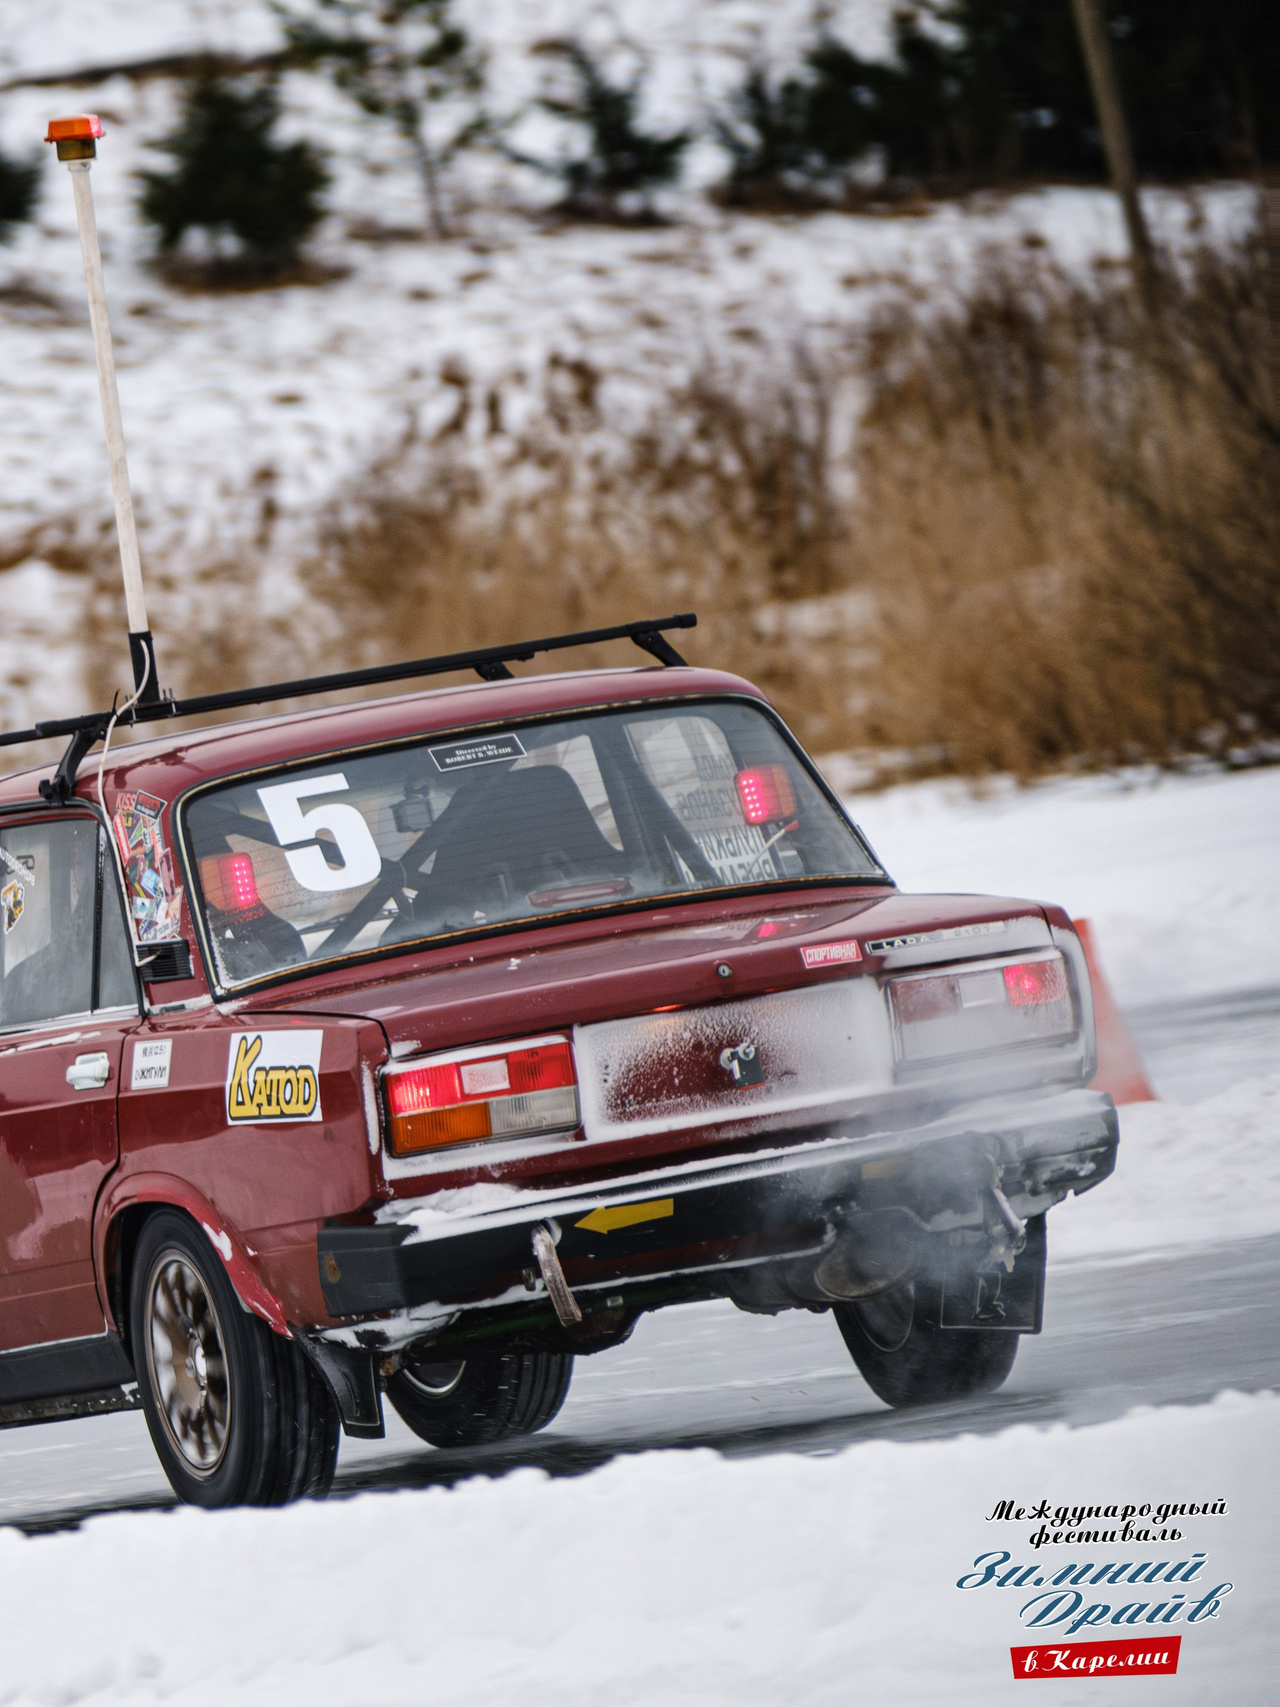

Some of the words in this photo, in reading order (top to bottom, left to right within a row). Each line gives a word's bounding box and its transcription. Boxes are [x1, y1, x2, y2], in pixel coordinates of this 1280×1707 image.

[256, 772, 382, 892] 5
[883, 934, 930, 949] LADA
[806, 942, 857, 964] СПОРТИВНАЯ
